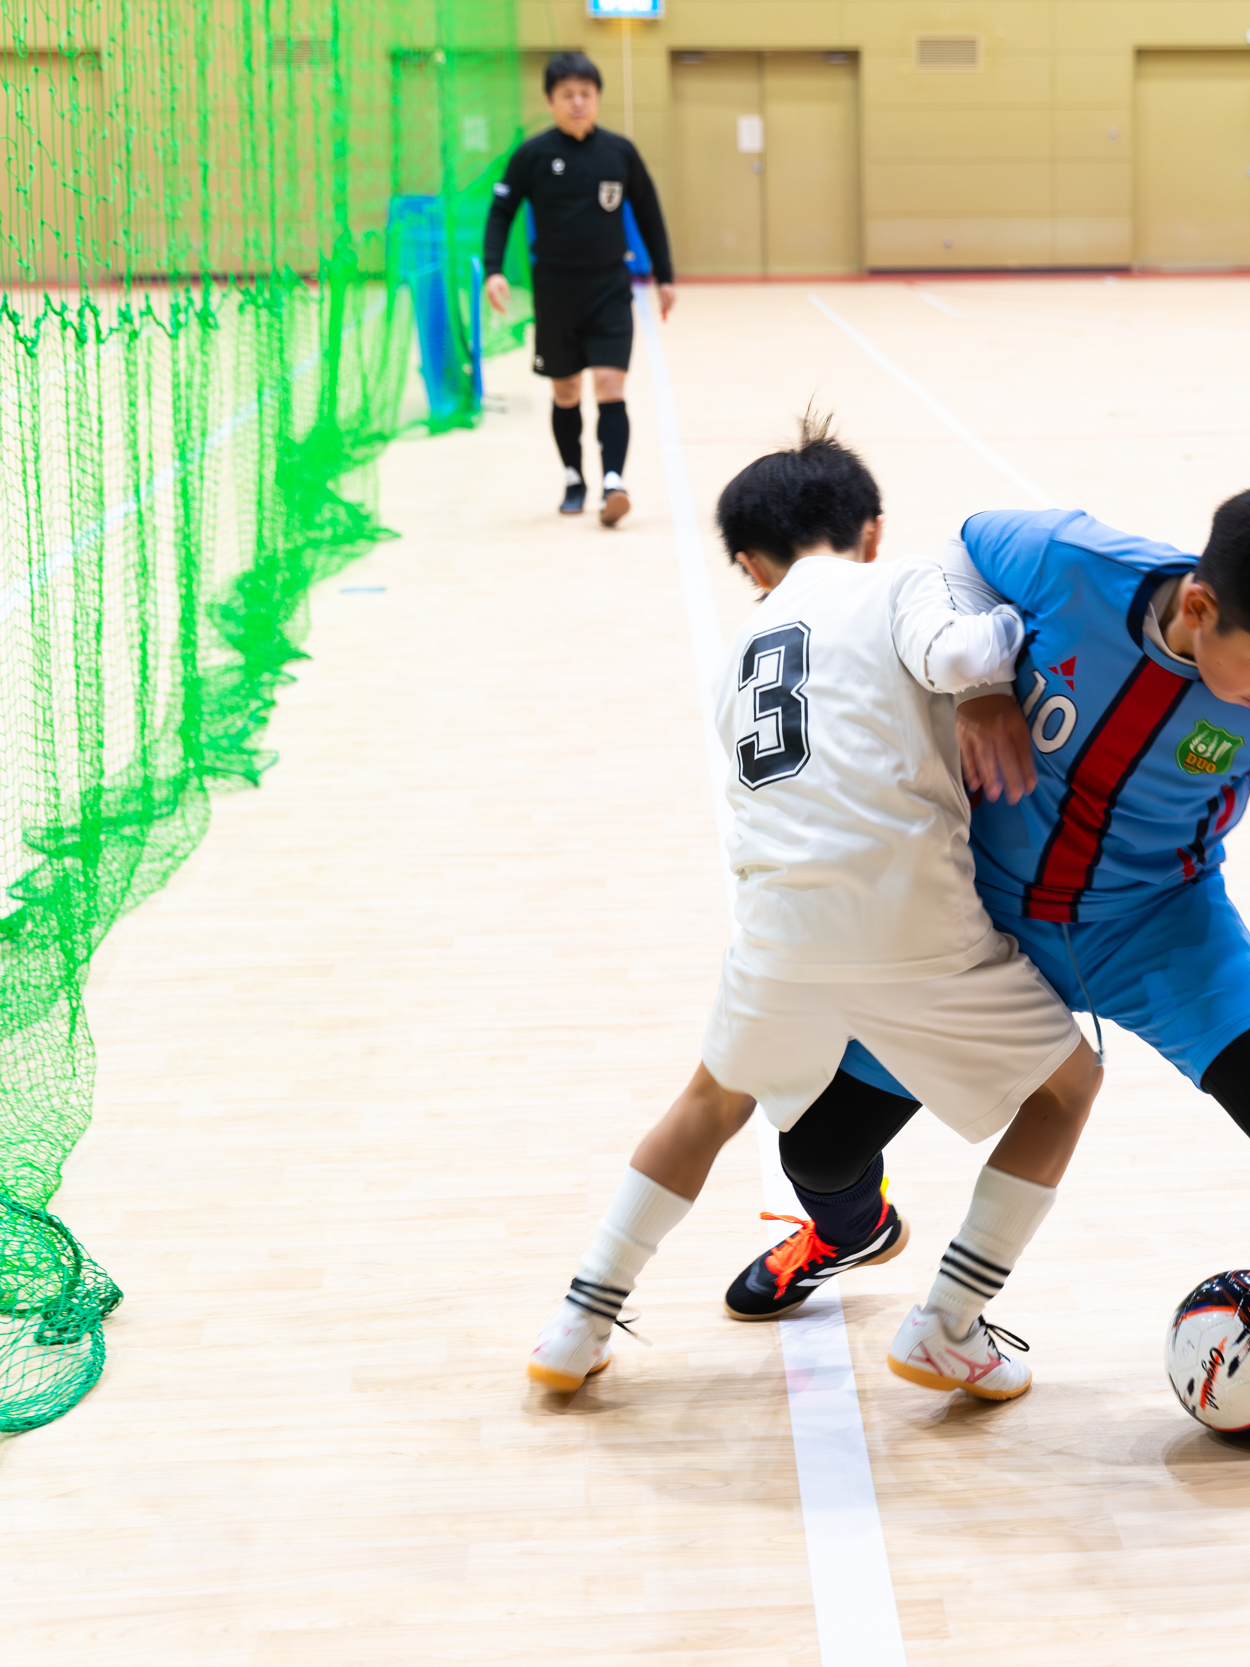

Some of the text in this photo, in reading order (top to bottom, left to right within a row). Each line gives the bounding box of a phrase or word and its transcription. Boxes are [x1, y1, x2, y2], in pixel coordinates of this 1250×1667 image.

[736, 620, 812, 792] 3
[1021, 669, 1079, 755] 10
[1184, 751, 1217, 774] DUO
